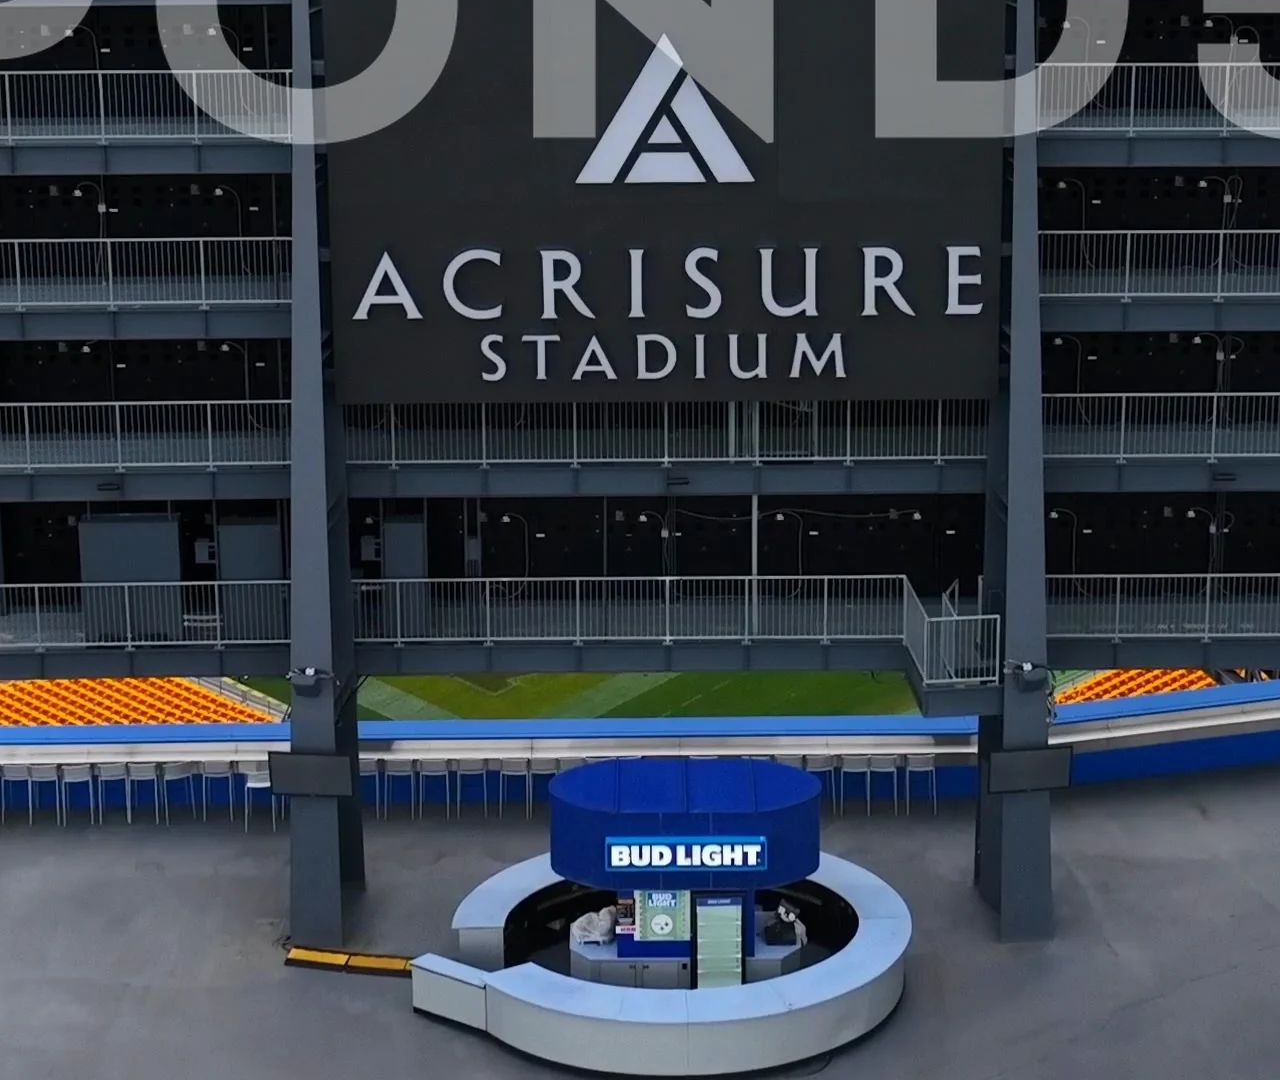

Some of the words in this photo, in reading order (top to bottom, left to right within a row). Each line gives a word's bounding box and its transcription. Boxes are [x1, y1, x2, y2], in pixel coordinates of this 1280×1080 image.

[352, 246, 984, 319] ACRISURE
[480, 332, 847, 382] STADIUM
[611, 845, 672, 866] BUD
[676, 844, 761, 866] LIGHT
[648, 899, 676, 908] LIGHT
[652, 893, 672, 901] BUD
